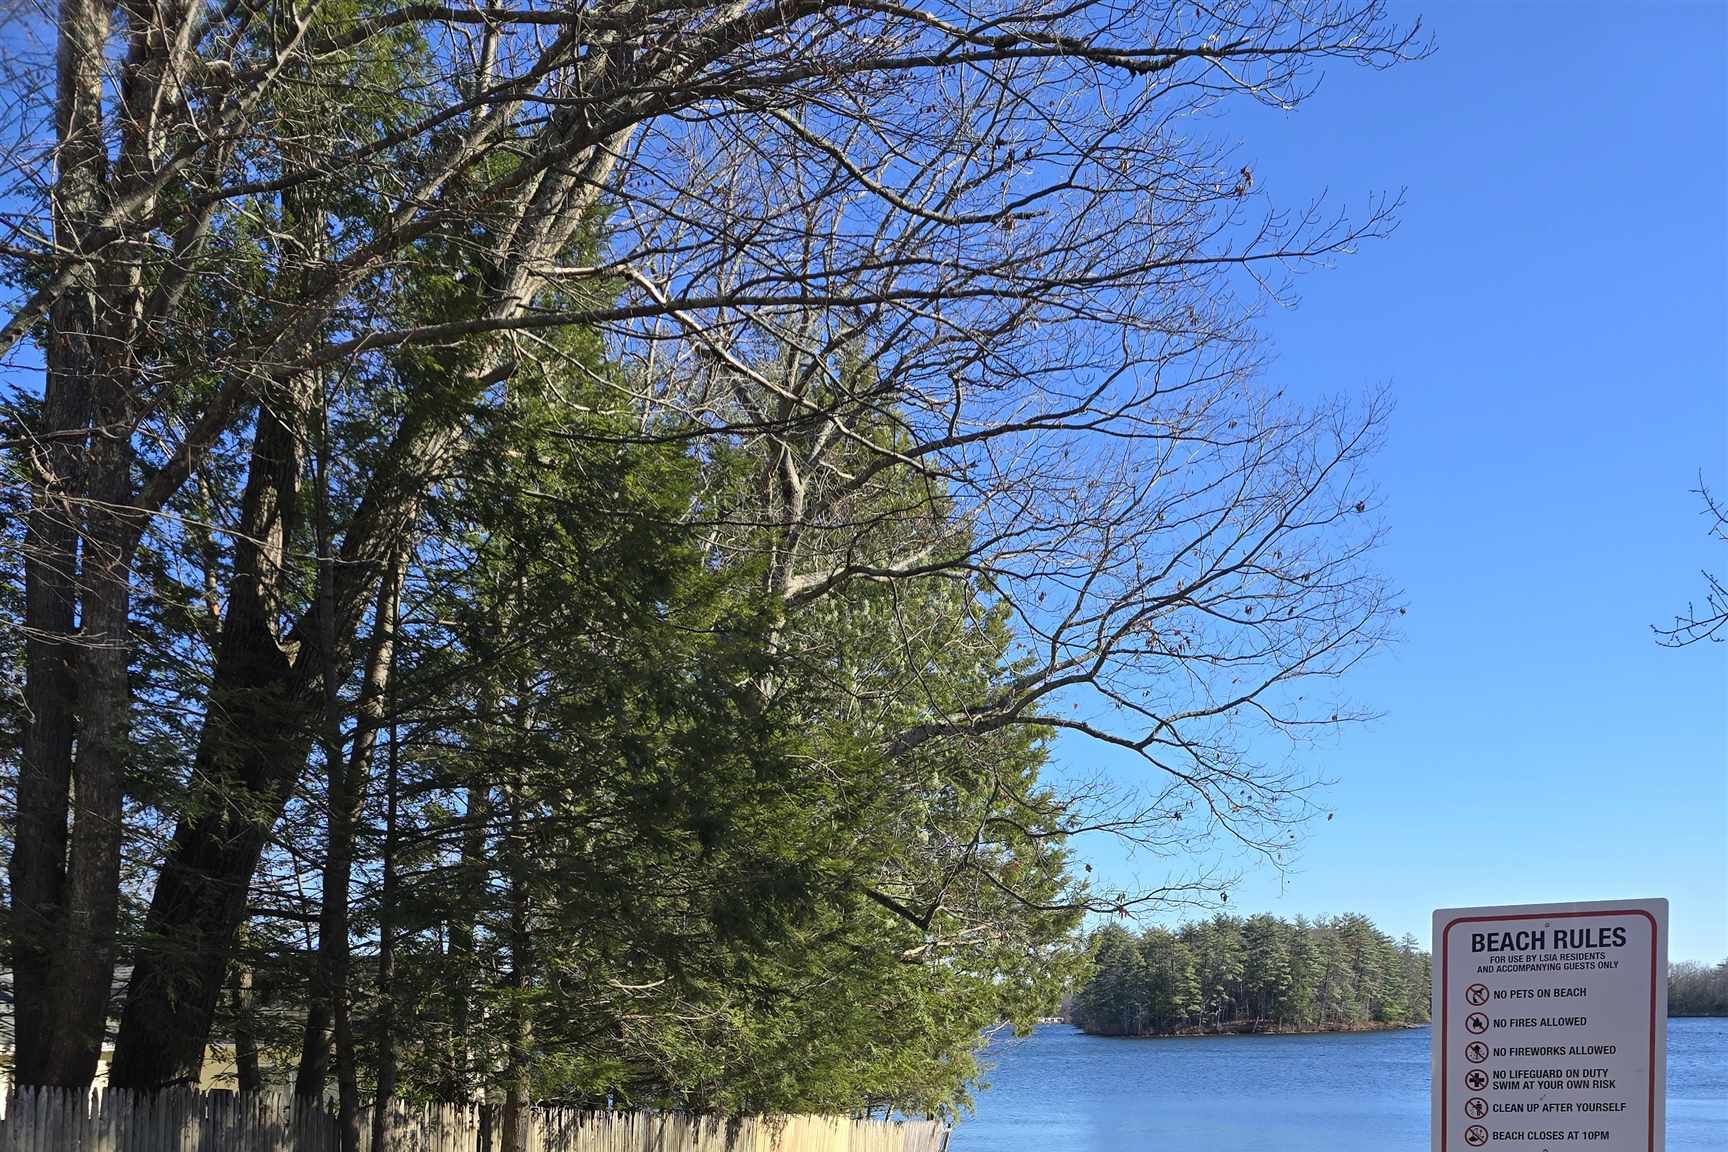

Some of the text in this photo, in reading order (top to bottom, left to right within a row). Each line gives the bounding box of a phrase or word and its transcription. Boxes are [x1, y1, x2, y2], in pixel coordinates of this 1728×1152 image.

[1472, 927, 1626, 952] BEACH RULES
[1508, 955, 1523, 963] USE
[1539, 953, 1557, 962] LSIA
[1560, 952, 1606, 961] RESIDENTS
[1496, 963, 1561, 972] ACCOMPANYING
[1564, 962, 1595, 970] GUESTS
[1598, 961, 1618, 969] ONLY
[1494, 988, 1587, 999] NO PETS ON BEACH
[1493, 1017, 1587, 1028] NO FIRES ALLOWED
[1493, 1046, 1616, 1056] NO FIREWORKS ALLOWED
[1493, 1069, 1608, 1079] NO LIFEGUARD ON DUTY
[1492, 1080, 1616, 1090] SWIM AT YOUR OWN RISK
[1492, 1103, 1627, 1112] CLEAN UP AFTER YOURSELF
[1492, 1131, 1609, 1140] BEACH CLOSES AT 10PM
